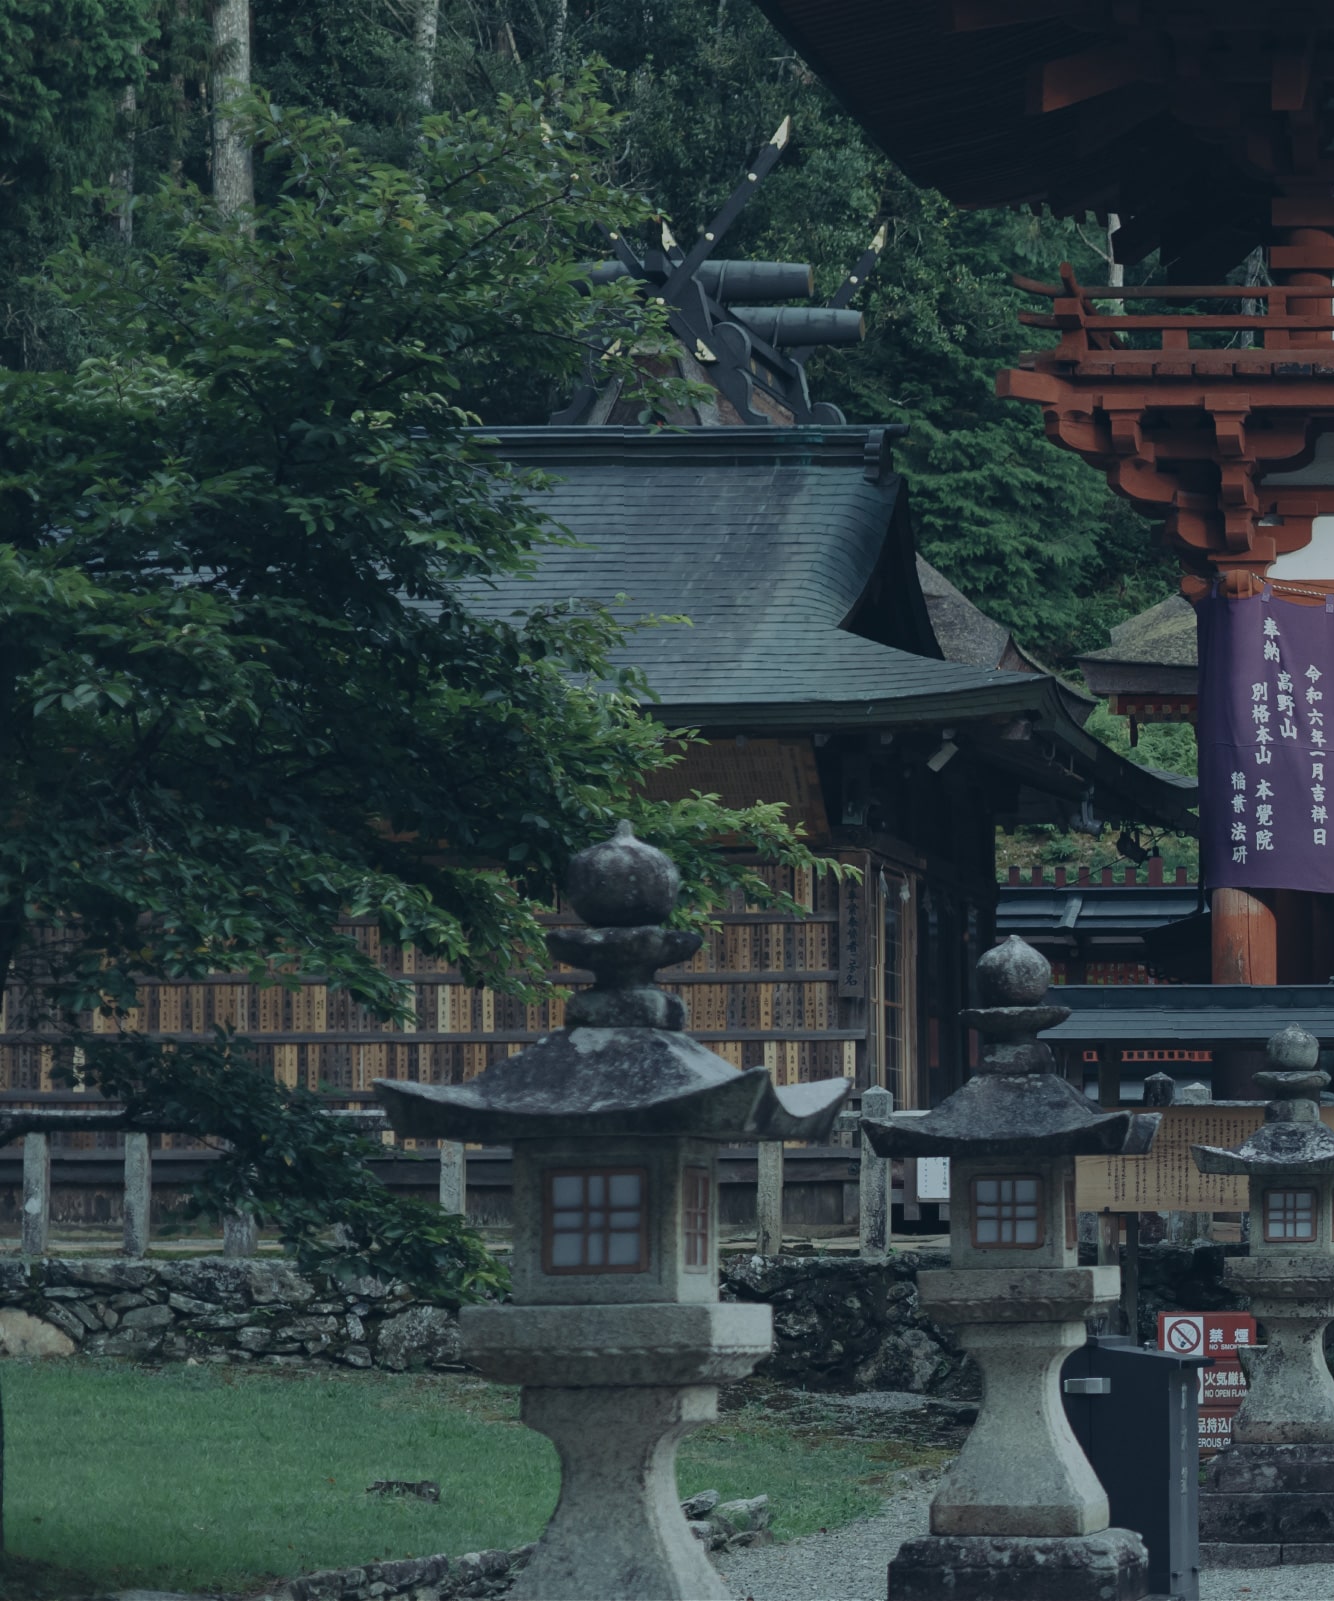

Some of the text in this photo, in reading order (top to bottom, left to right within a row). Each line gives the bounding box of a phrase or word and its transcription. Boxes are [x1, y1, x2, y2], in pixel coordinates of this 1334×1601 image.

[1262, 616, 1281, 664] 奉納
[1276, 670, 1298, 740] 高野山
[1303, 664, 1329, 846] 令和六年一月吉祥日
[1204, 1389, 1213, 1397] NO
[1215, 1389, 1231, 1397] OPEN
